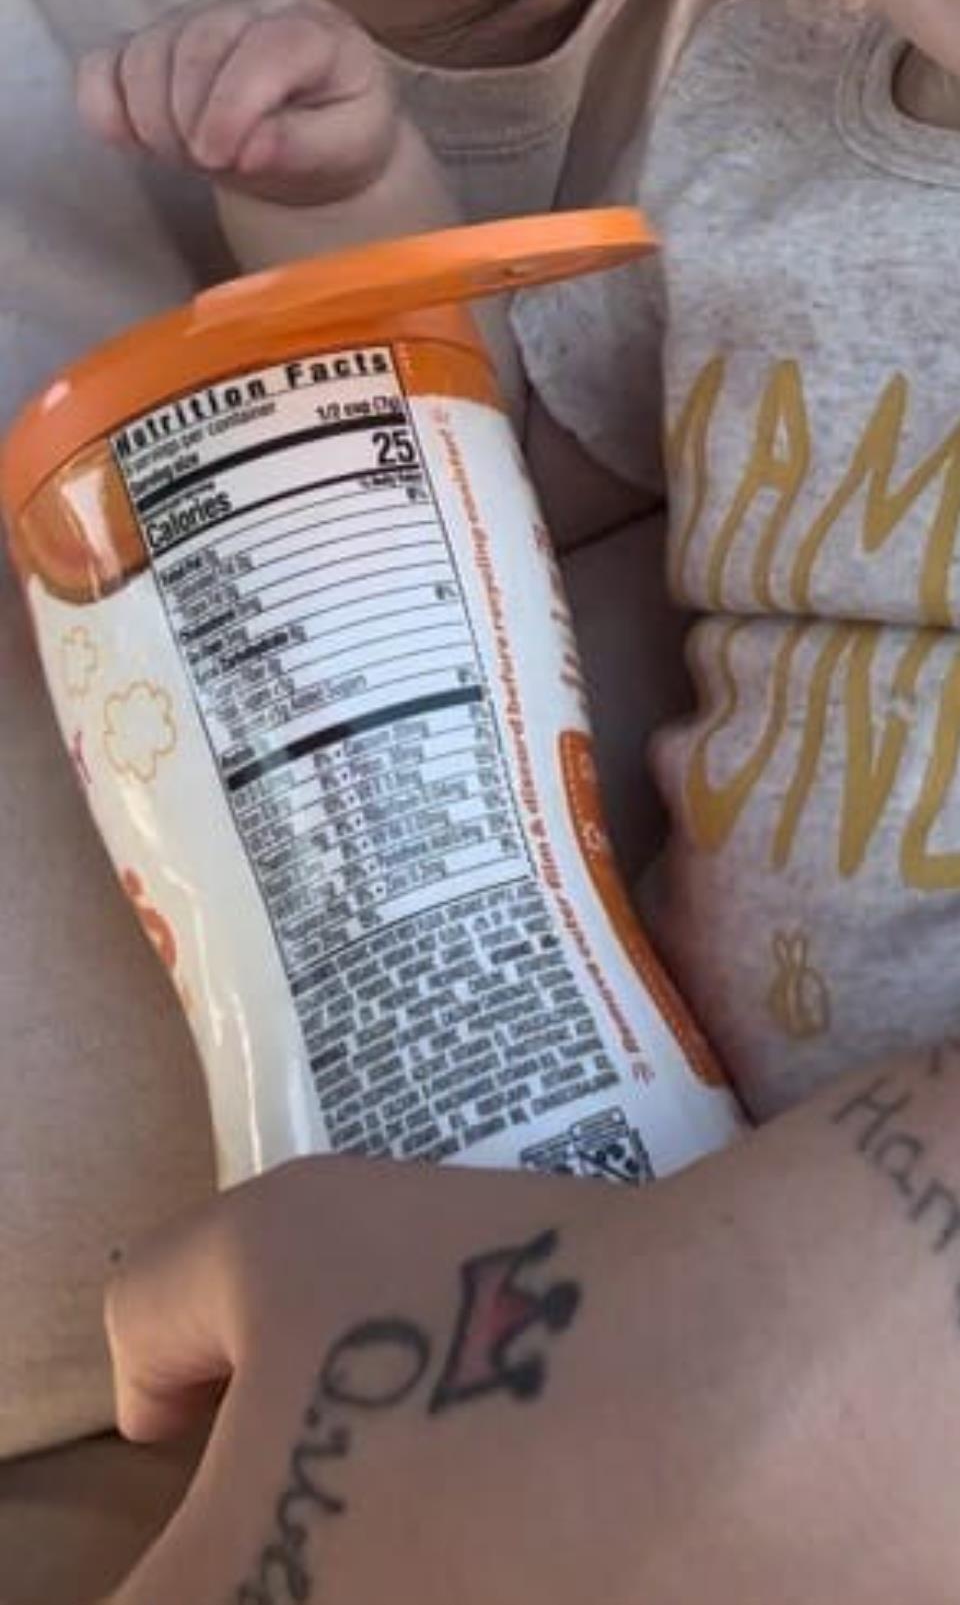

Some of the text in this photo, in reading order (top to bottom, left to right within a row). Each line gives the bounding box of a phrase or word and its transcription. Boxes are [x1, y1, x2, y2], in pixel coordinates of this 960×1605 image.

[115, 352, 388, 456] Nutrition Facts
[147, 492, 233, 548] Calories
[371, 429, 415, 464] 25
